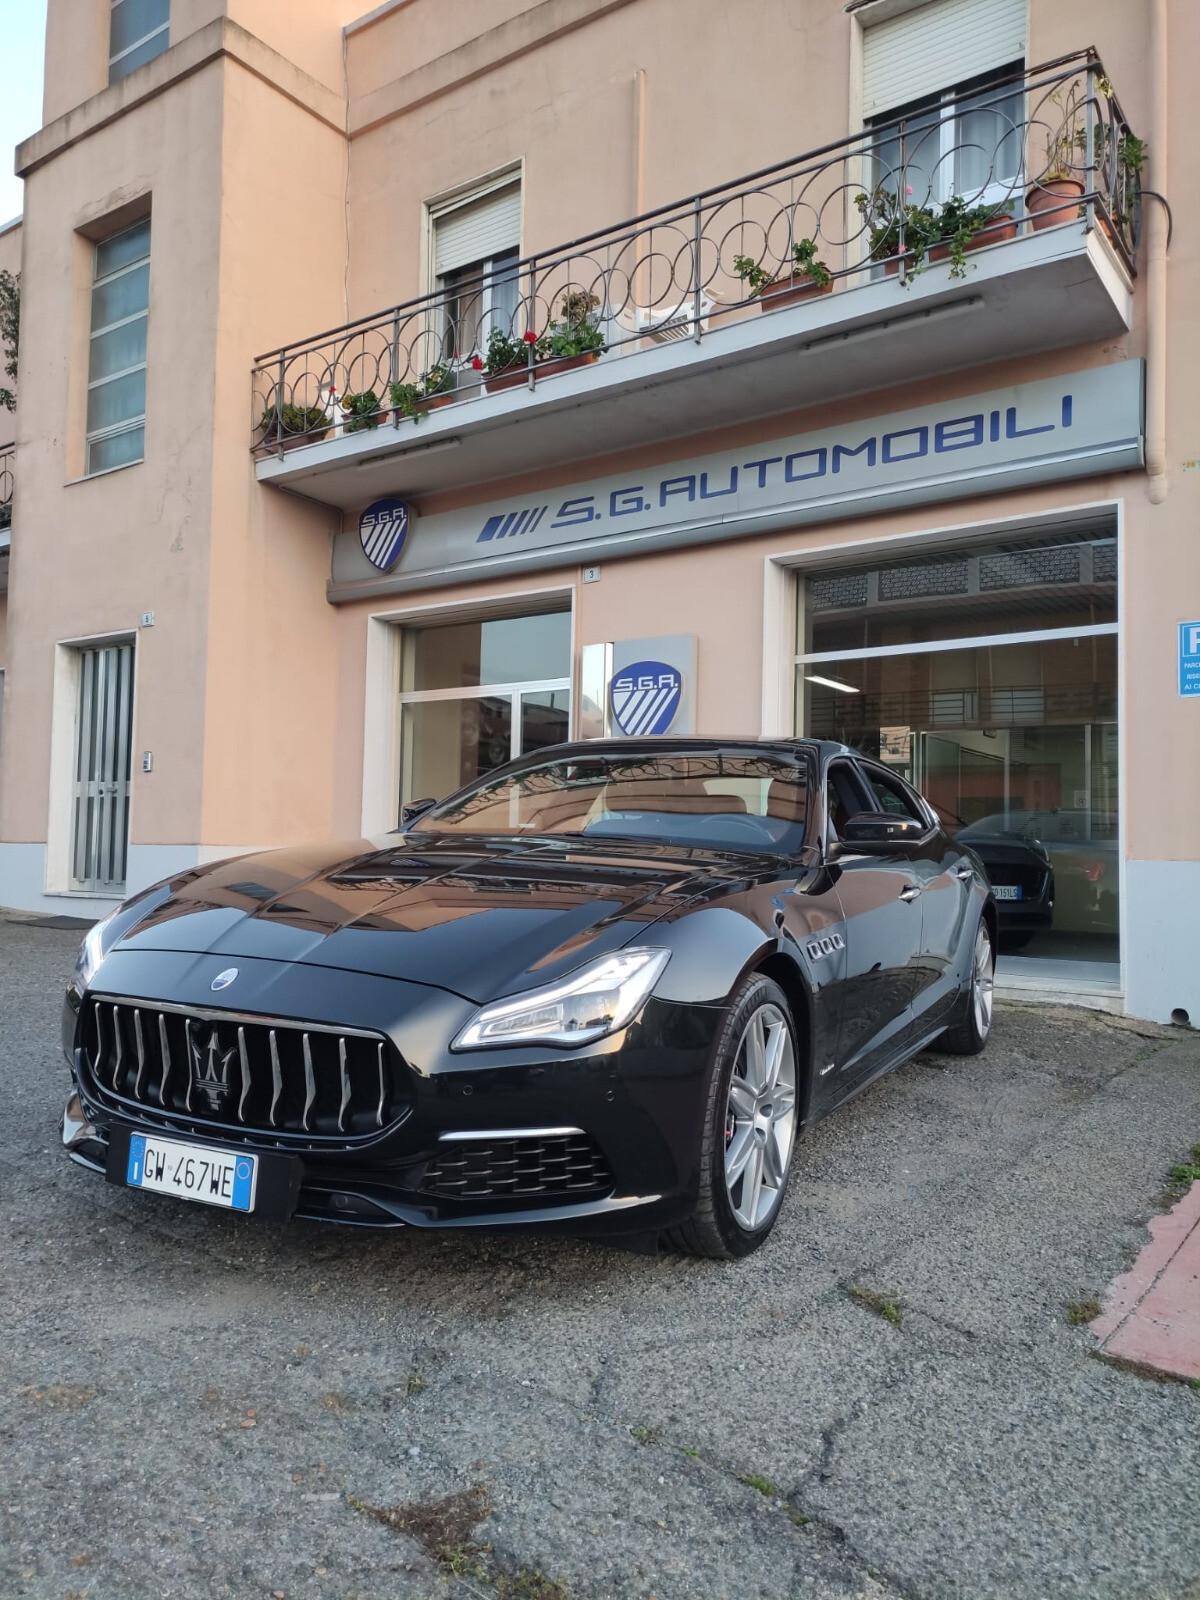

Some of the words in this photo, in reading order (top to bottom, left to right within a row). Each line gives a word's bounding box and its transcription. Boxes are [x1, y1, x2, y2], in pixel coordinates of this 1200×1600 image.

[360, 507, 407, 528] S.G.A.
[589, 569, 594, 579] 3
[613, 674, 679, 693] S.G.A.
[144, 1148, 166, 1182] GW
[173, 1156, 234, 1199] 467WE
